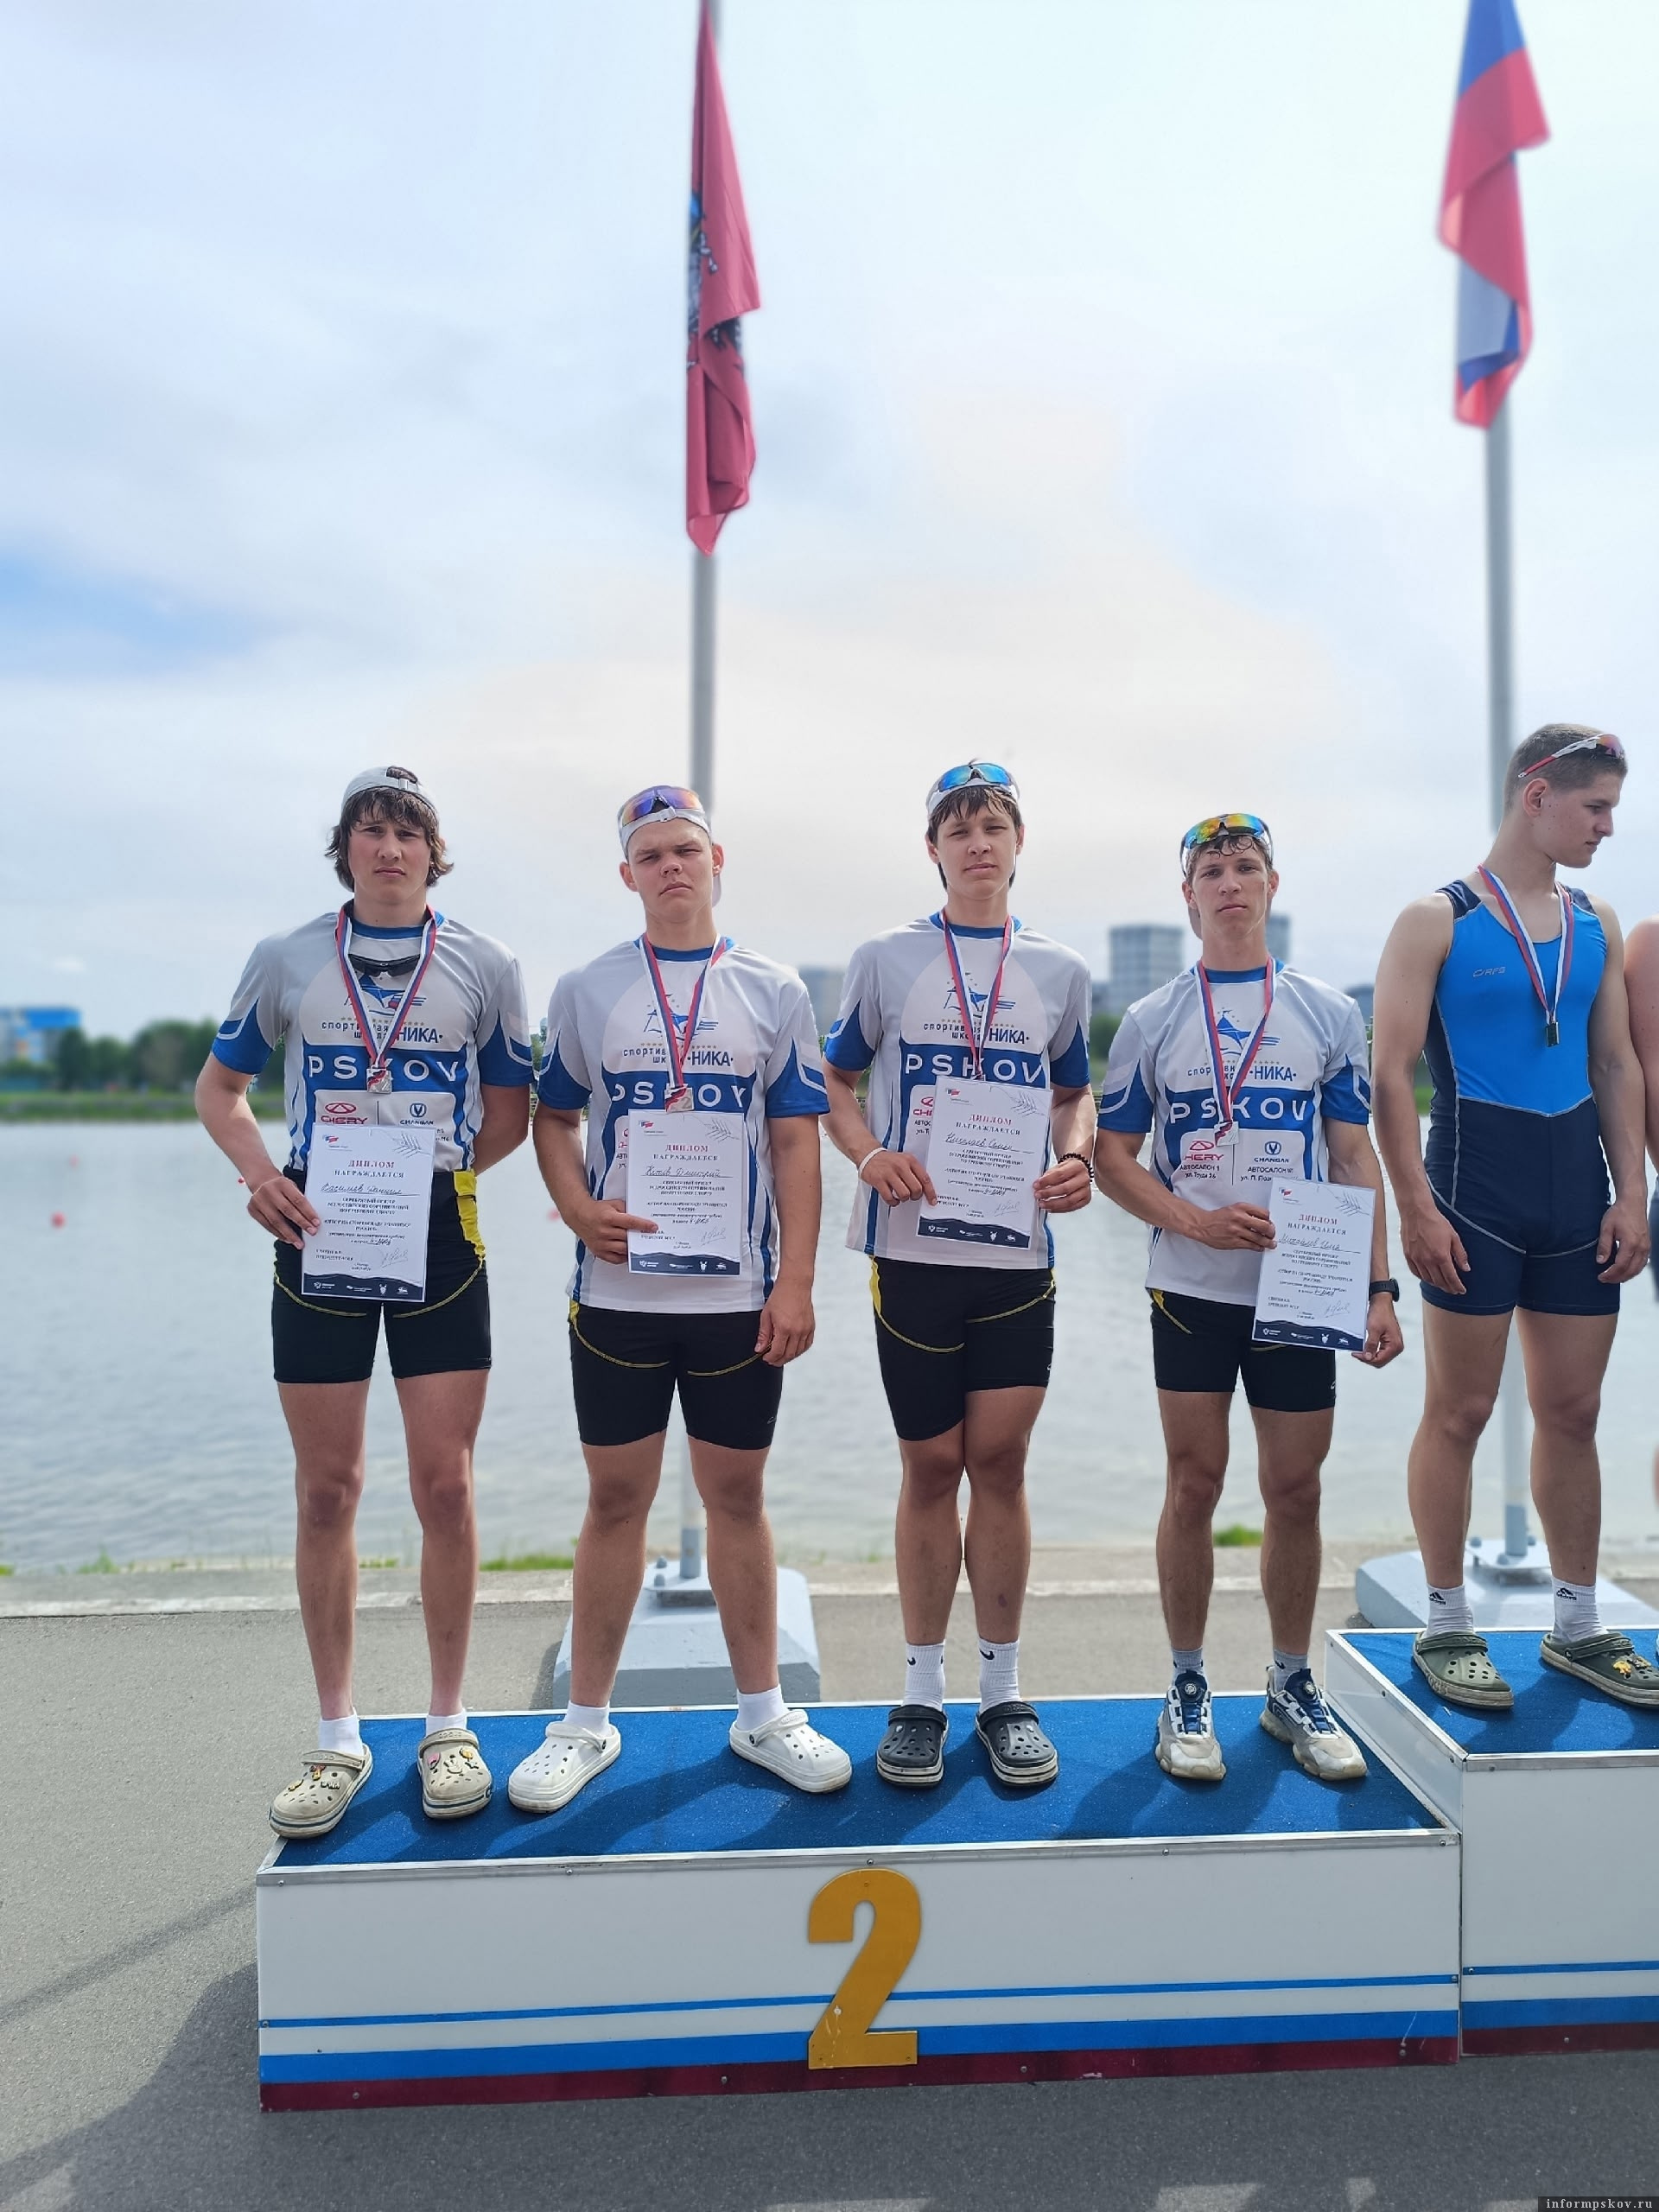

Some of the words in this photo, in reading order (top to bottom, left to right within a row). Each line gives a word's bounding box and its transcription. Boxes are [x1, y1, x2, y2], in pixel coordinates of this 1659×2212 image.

[321, 1021, 389, 1033] спортая
[623, 1048, 666, 1058] спортив
[308, 1055, 459, 1082] PSOV
[611, 1081, 747, 1108] PSOV
[1170, 1096, 1307, 1124] PSKOV
[665, 1144, 709, 1153] ДИПЛОМ
[348, 1160, 395, 1169] ДИПЛОМ
[1298, 1213, 1338, 1225] ДИПЛОМ
[808, 1867, 922, 2069] 2
